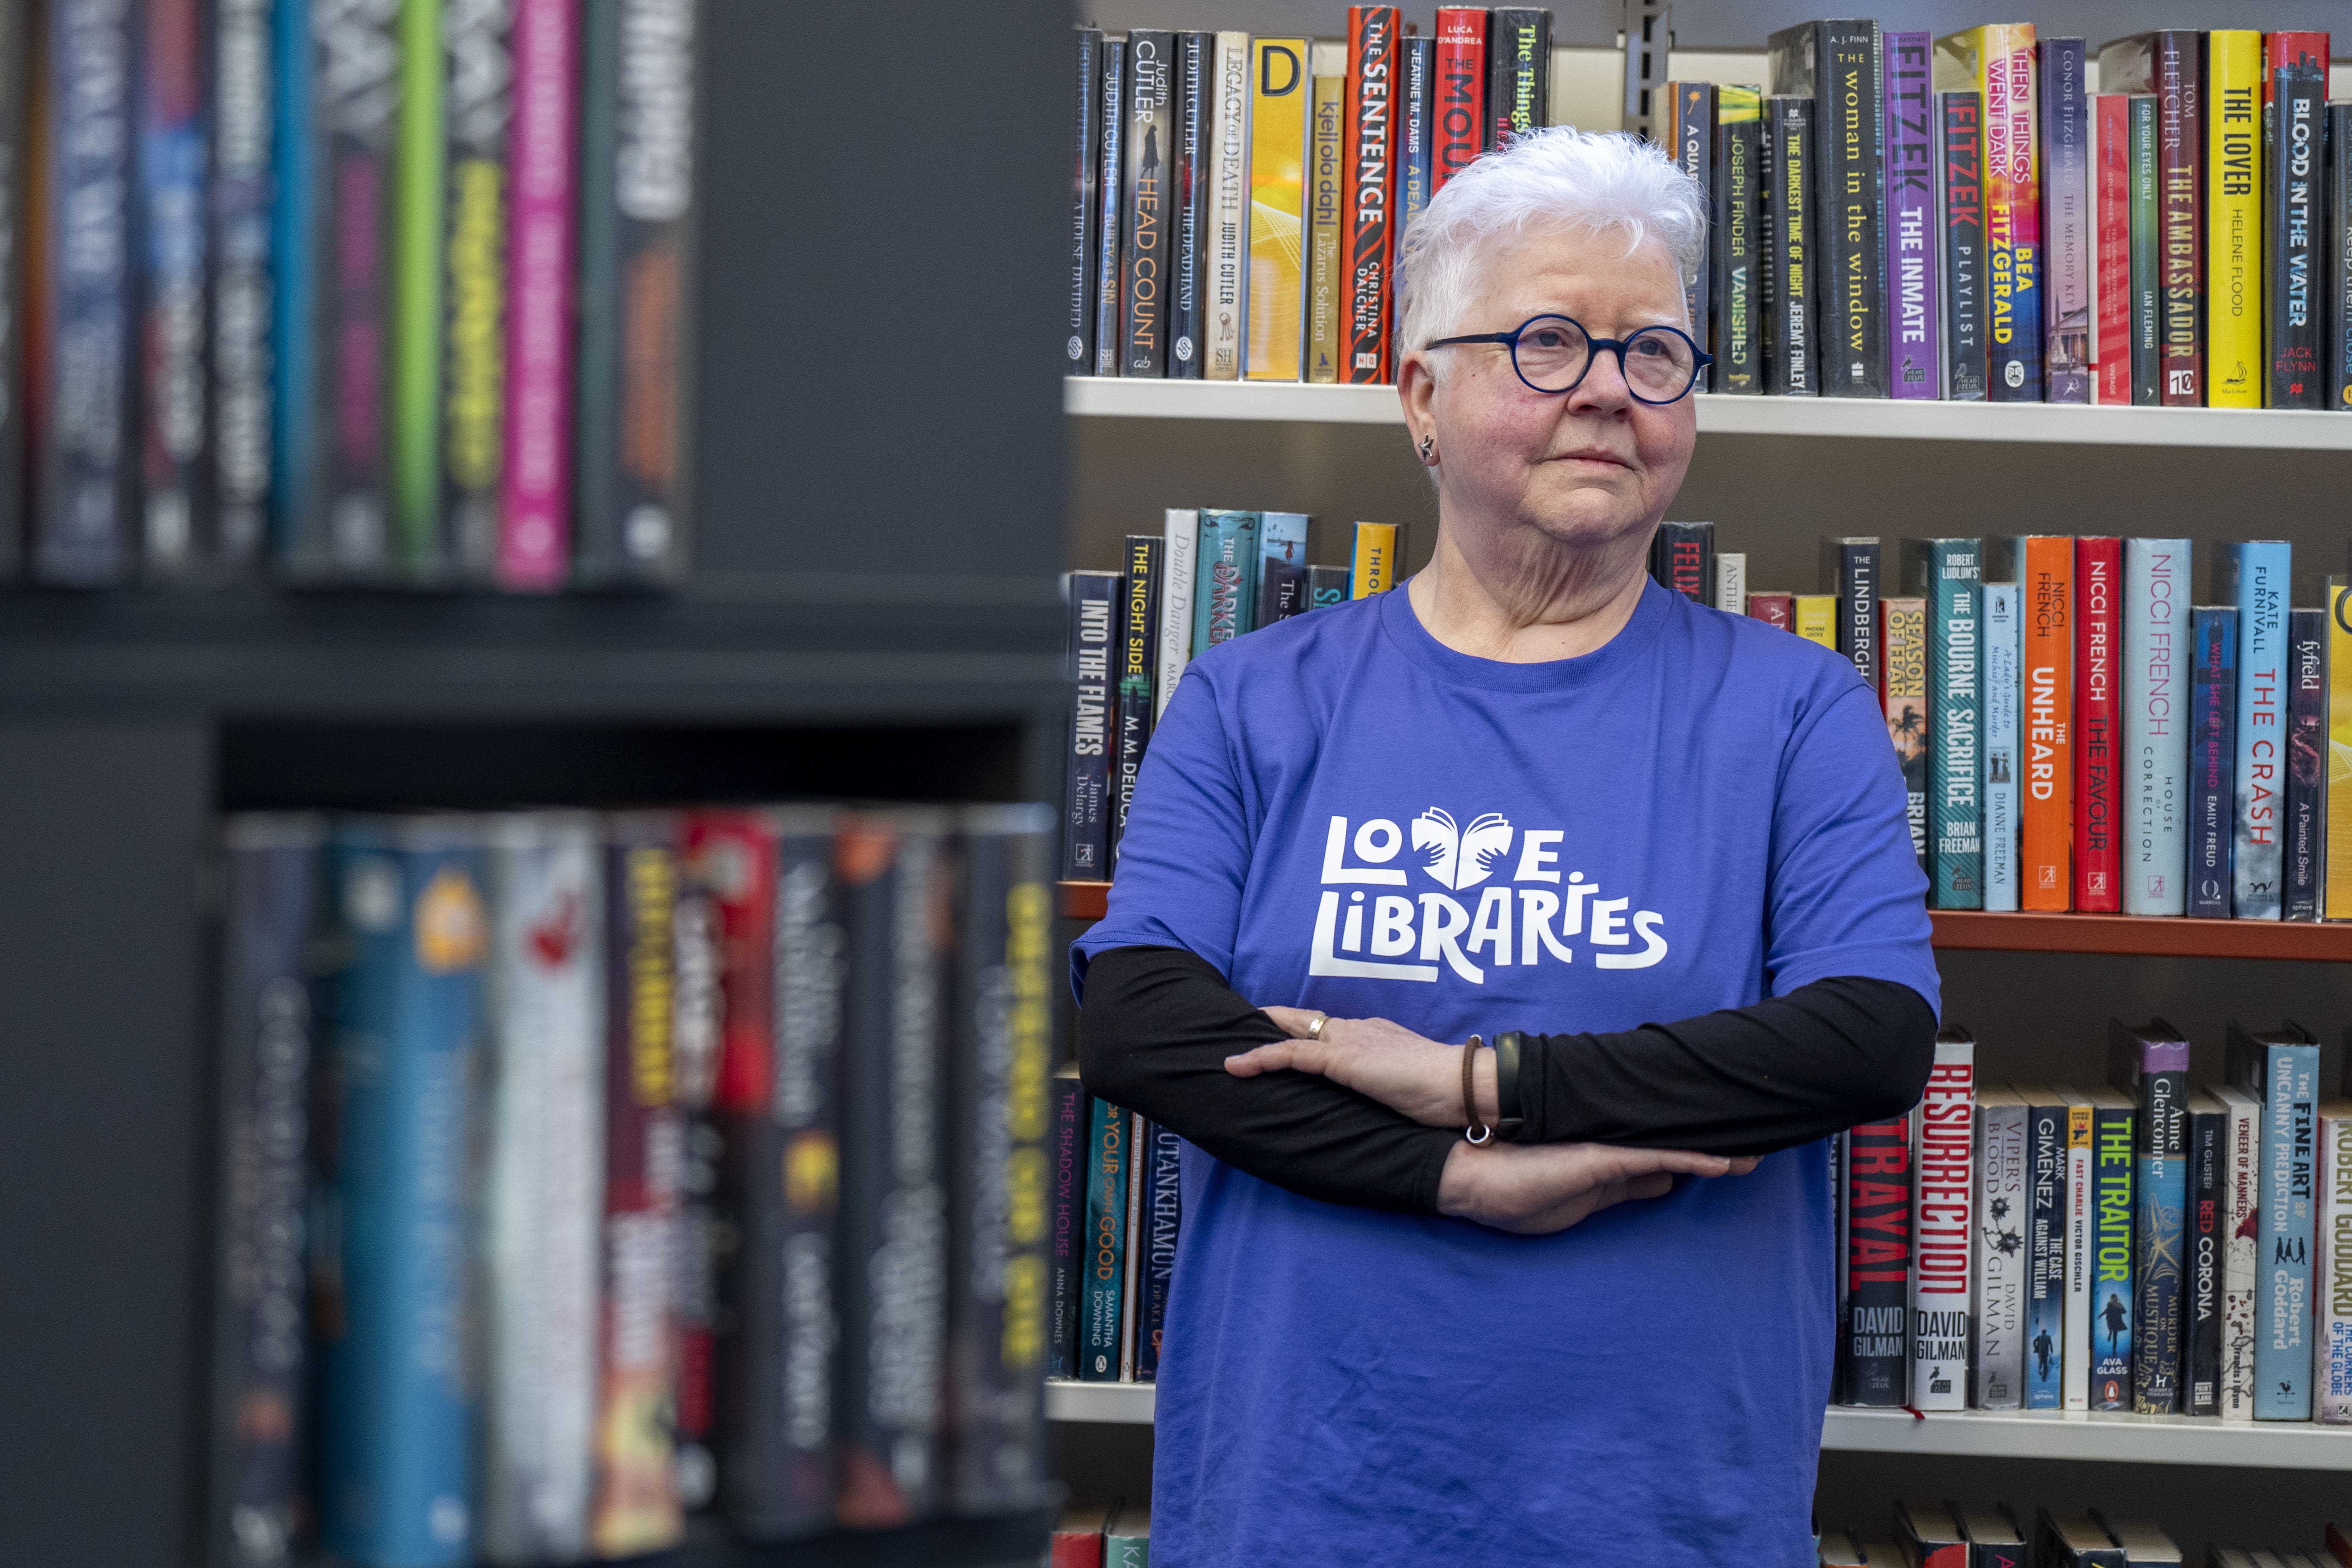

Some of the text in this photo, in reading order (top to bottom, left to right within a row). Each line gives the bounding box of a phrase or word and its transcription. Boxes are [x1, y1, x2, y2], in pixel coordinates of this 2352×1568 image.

[1135, 41, 1156, 123] CUTLER
[1155, 60, 1168, 106] Judith
[1261, 45, 1300, 97] D
[1838, 53, 1864, 63] THE
[1359, 22, 1387, 222] THE SENTENCE
[1989, 60, 2007, 178] WENT DARK
[2012, 50, 2031, 184] THEN THINGS
[2164, 50, 2180, 151] FLETCHER
[2184, 81, 2196, 118] TOM
[1787, 135, 1800, 156] THE
[1947, 106, 1978, 226] FITZEK
[2063, 50, 2075, 306] CONOR FITZGERALD THE MEMORY KEY
[1788, 160, 1801, 211] DARKEST
[1845, 70, 1868, 352] woman in the window
[1891, 46, 1928, 343] FITZEK THE INMATE
[2224, 86, 2251, 316] THE LOVER HELENE FLOOD
[2289, 99, 2310, 327] BLOOD IN THE WATER
[1134, 179, 1158, 349] HEAD COUNT
[1732, 135, 1747, 364] JOSEPH FINDER VANISHED
[1788, 215, 1802, 243] TIME
[1789, 247, 1802, 260] OF
[2141, 104, 2153, 349] FOR YOUR EYES ONLY IAN FLEMING
[2168, 165, 2194, 357] THE AMBASSADOR
[1356, 268, 1368, 330] DALCHER
[1367, 262, 1379, 338] CHRISTINA
[1789, 264, 1802, 297] NIGHT
[1959, 246, 1973, 346] PLAYLIST
[1992, 205, 2013, 344] FITZGERALD
[2015, 248, 2033, 292] BEA
[1790, 301, 1804, 348] JEREMY
[2280, 347, 2311, 358] JACK
[1791, 349, 1805, 388] FINLEY
[2276, 361, 2316, 372] FLYNN
[1673, 542, 1700, 594] FELIX
[1947, 554, 1974, 566] ROBERT
[1128, 544, 1149, 674] THE NIGHT SIDE
[2037, 572, 2051, 637] FRENCH
[2052, 582, 2065, 627] NICCI
[2253, 566, 2266, 654] FURNIVALL
[2267, 591, 2278, 629] KATE
[1075, 599, 1108, 756] INTO THE FLAMES
[1889, 610, 1906, 697] OF FEAR
[1906, 611, 1924, 696] SEASON
[2148, 555, 2171, 735] NICCI FRENCH
[1947, 592, 1975, 807] THE BOURNE SACRIFICE
[2031, 667, 2055, 800] UNHEARD
[2056, 722, 2065, 744] THE
[2088, 561, 2108, 851] NICCI FRENCH THE FAVOUR
[2206, 642, 2221, 867] WHAT SHE LEFT BEHIND EMILY FREUD
[2250, 669, 2275, 845] THE CRASH
[1947, 821, 1975, 836] BRIAN
[2143, 747, 2153, 862] CORRECTION
[2164, 776, 2172, 833] HOUSE
[1939, 838, 1980, 853] FREEMAN
[2297, 803, 2310, 886] A Painted Smile
[1987, 1123, 2000, 1194] BLOOD
[2005, 1122, 2022, 1192] VIPER'S
[2036, 1118, 2054, 1209] GIMENEZ
[2055, 1147, 2065, 1180] MARK
[2152, 1078, 2171, 1178] Glenconner
[2169, 1106, 2184, 1150] Anne
[1097, 1122, 1120, 1280] YOUR OWN GOOD
[2075, 1182, 2083, 1216] CHARLIE
[2099, 1117, 2132, 1282] THE TRAITOR
[2236, 1118, 2249, 1219] VENEER OF MANNERS
[1054, 1093, 1075, 1344] THE SHADOW HOUSE ANNA DOWNES
[2198, 1129, 2214, 1321] TIM GLISTER RED CORONA
[1986, 1256, 2002, 1356] GILMAN
[2004, 1284, 2015, 1330] DAVID
[2074, 1253, 2082, 1292] GISCHLER
[2274, 1270, 2288, 1350] Goddard
[1092, 1291, 1102, 1346] DOWNING
[1853, 1336, 1903, 1356] GILMAN
[1854, 1307, 1903, 1334] DAVID
[1917, 1310, 1966, 1337] DAVID
[1917, 1340, 1965, 1360] GILMAN
[2144, 1284, 2159, 1364] MUSTIQUE
[2167, 1295, 2178, 1353] MURDER
[2288, 1277, 2304, 1347] Robert
[2097, 1367, 2127, 1375] GLASS
[2102, 1358, 2123, 1366] AVA
